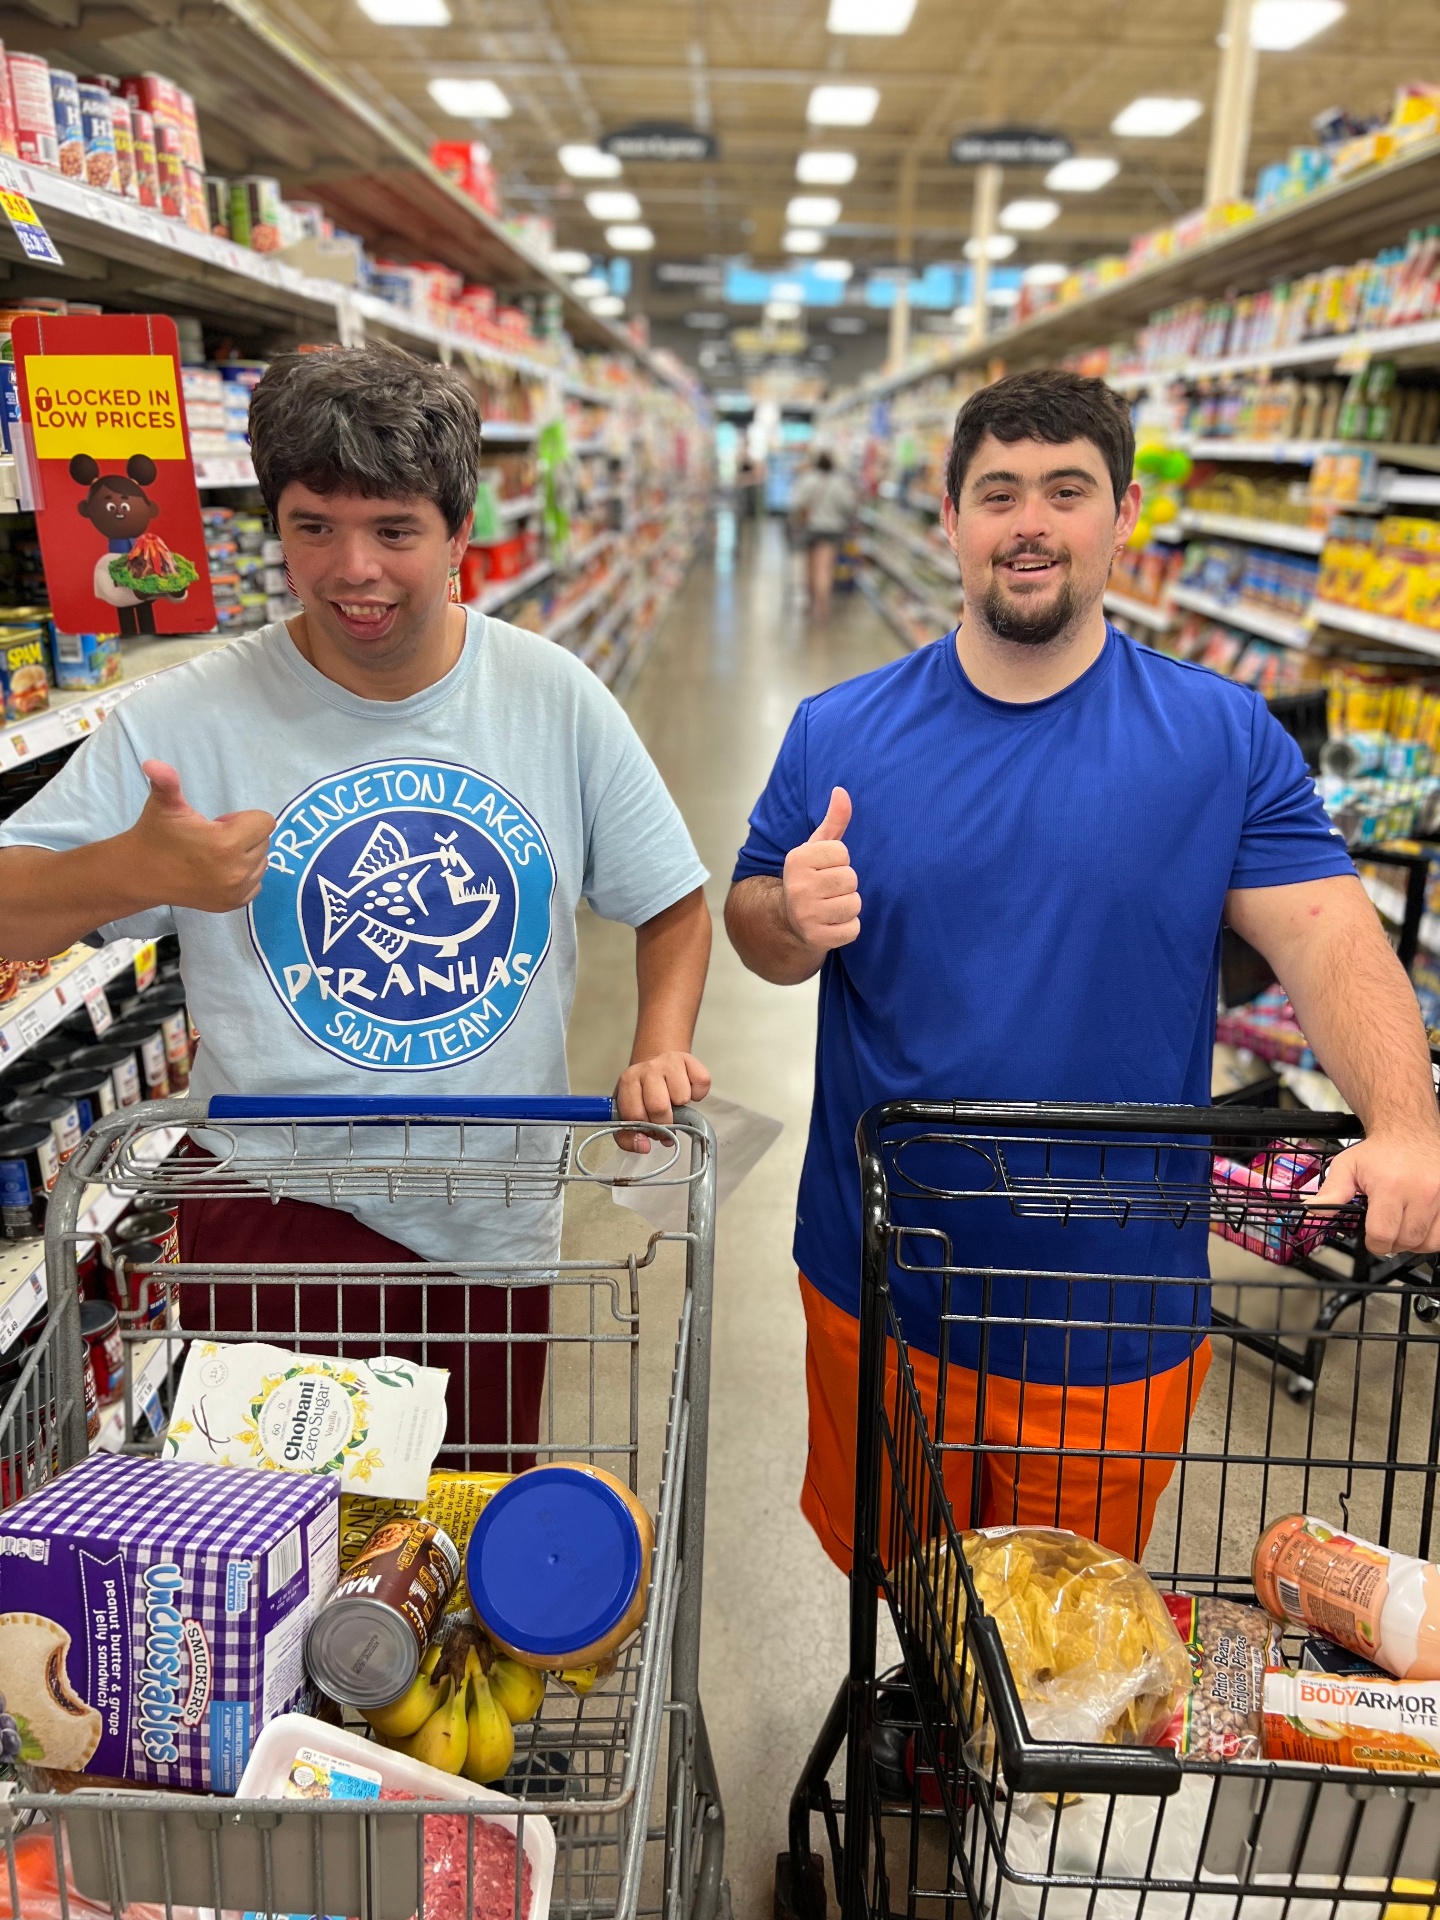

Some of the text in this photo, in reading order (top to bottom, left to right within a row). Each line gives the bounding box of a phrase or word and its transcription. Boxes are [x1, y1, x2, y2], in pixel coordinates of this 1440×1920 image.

[55, 389, 171, 407] LOCKED IN
[36, 410, 177, 429] LOW PRICES
[7, 641, 43, 671] SPAM
[267, 769, 543, 877] PRINCETON LAKES
[326, 998, 502, 1064] SWIM TEAM
[7, 1320, 19, 1337] 5.49
[271, 1423, 282, 1436] 60
[284, 1381, 316, 1461] Chobani
[325, 1411, 338, 1437] Vanilla
[426, 1489, 437, 1508] pride
[435, 1496, 444, 1508] the
[446, 1501, 453, 1510] be
[455, 1491, 464, 1508] that
[474, 1495, 482, 1516] colors
[445, 1512, 451, 1520] to
[460, 1520, 469, 1540] MADE
[465, 1498, 473, 1517] WITH
[35, 1544, 43, 1556] 210
[237, 1560, 251, 1580] 10
[1352, 1586, 1361, 1603] Facts
[92, 1609, 108, 1708] jelly sandwich
[103, 1579, 123, 1736] peanut butter & grape
[140, 1563, 185, 1765] Uncrustables
[186, 1627, 209, 1724] SMUCKER'S
[1211, 1636, 1231, 1702] Pinto Beans
[1229, 1634, 1250, 1715] Frijoles Pintos
[1301, 1679, 1328, 1688] Orange
[1300, 1684, 1437, 1715] BODYARMOR
[235, 1706, 243, 1714] NO
[1401, 1712, 1438, 1727] LYTE
[235, 1715, 243, 1729] HIGH
[235, 1729, 243, 1757] FRUCTOSE
[222, 1753, 230, 1770] grams
[235, 1758, 243, 1773] CORN
